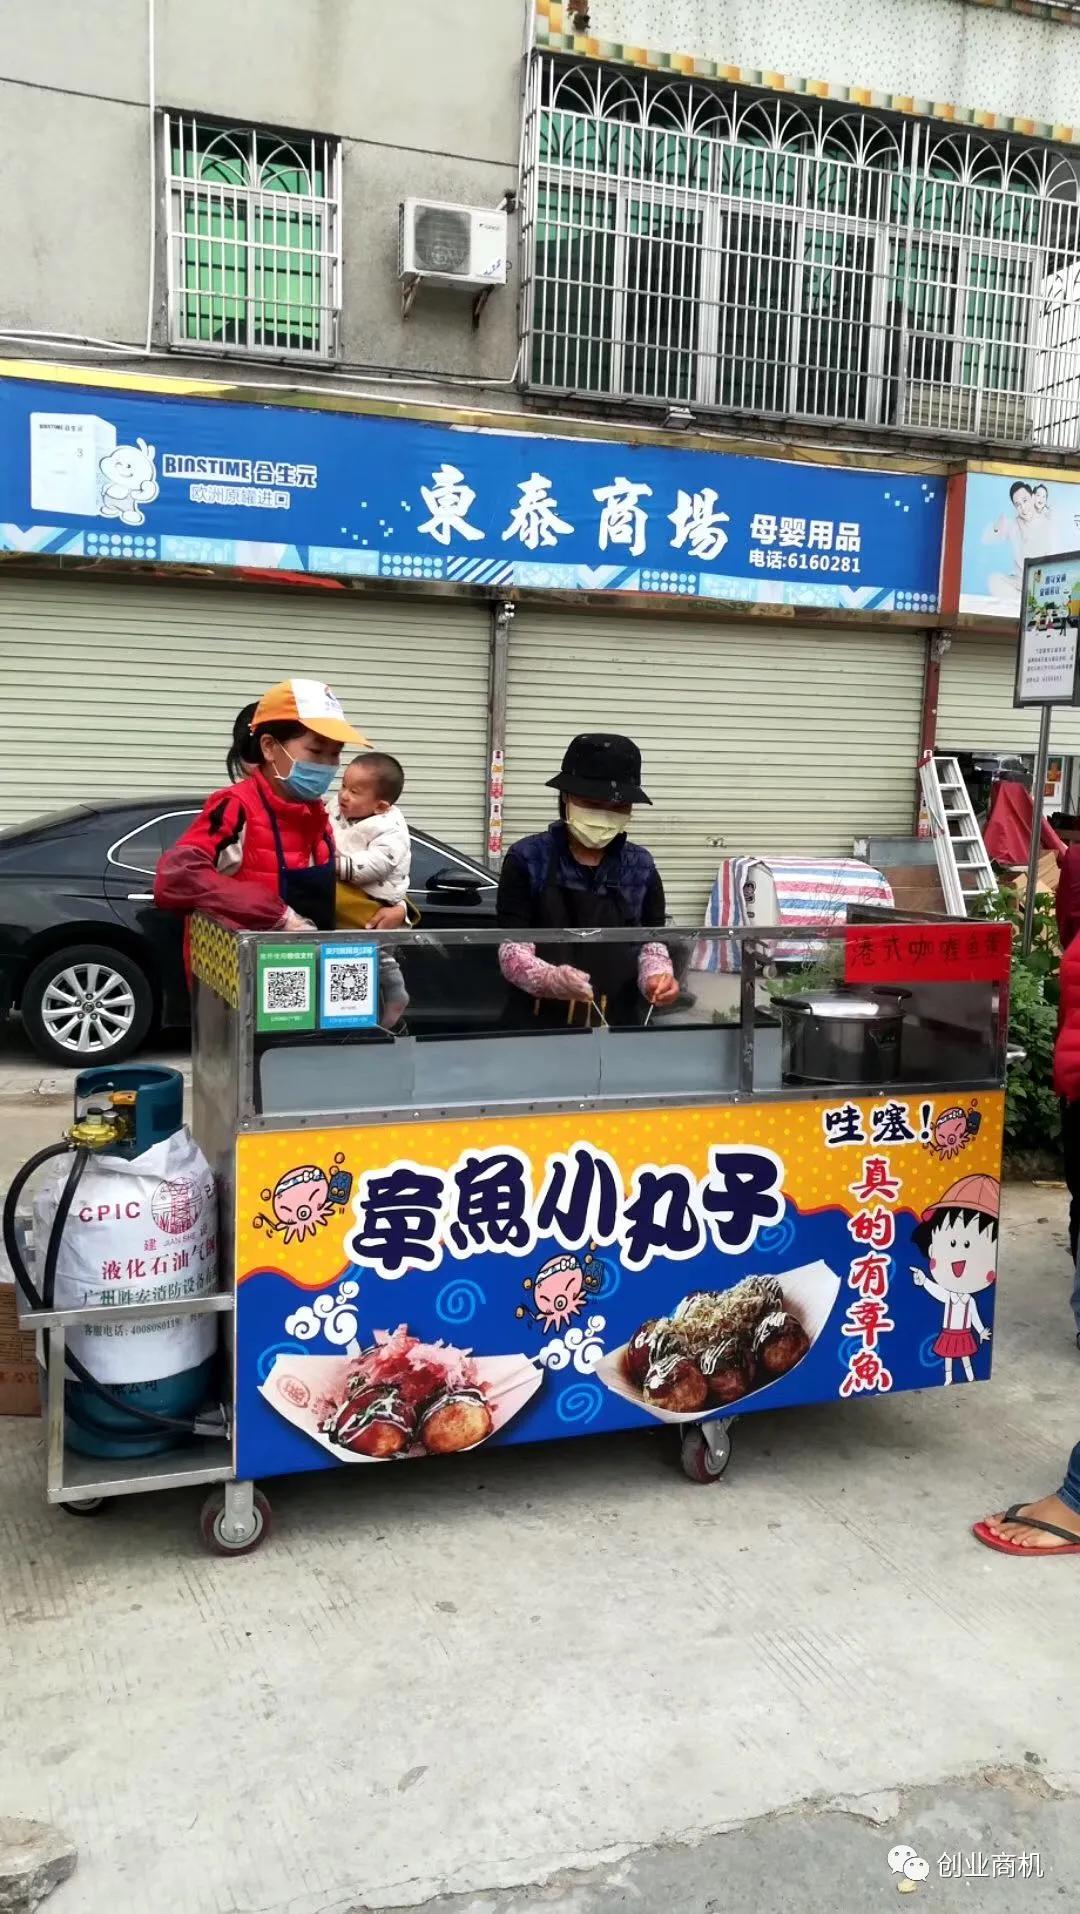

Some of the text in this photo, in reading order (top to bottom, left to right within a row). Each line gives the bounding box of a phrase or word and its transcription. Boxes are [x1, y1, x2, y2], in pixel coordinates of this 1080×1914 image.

[164, 455, 317, 487] BIOSTIME 合生元
[190, 486, 291, 508] 欧洲原罐进口
[416, 463, 731, 561] 東泰商場
[749, 512, 862, 553] 母婴用品
[79, 1201, 141, 1223] CPIC
[352, 1147, 781, 1272] 章魚小丸子
[842, 1157, 900, 1396] 真的有章魚
